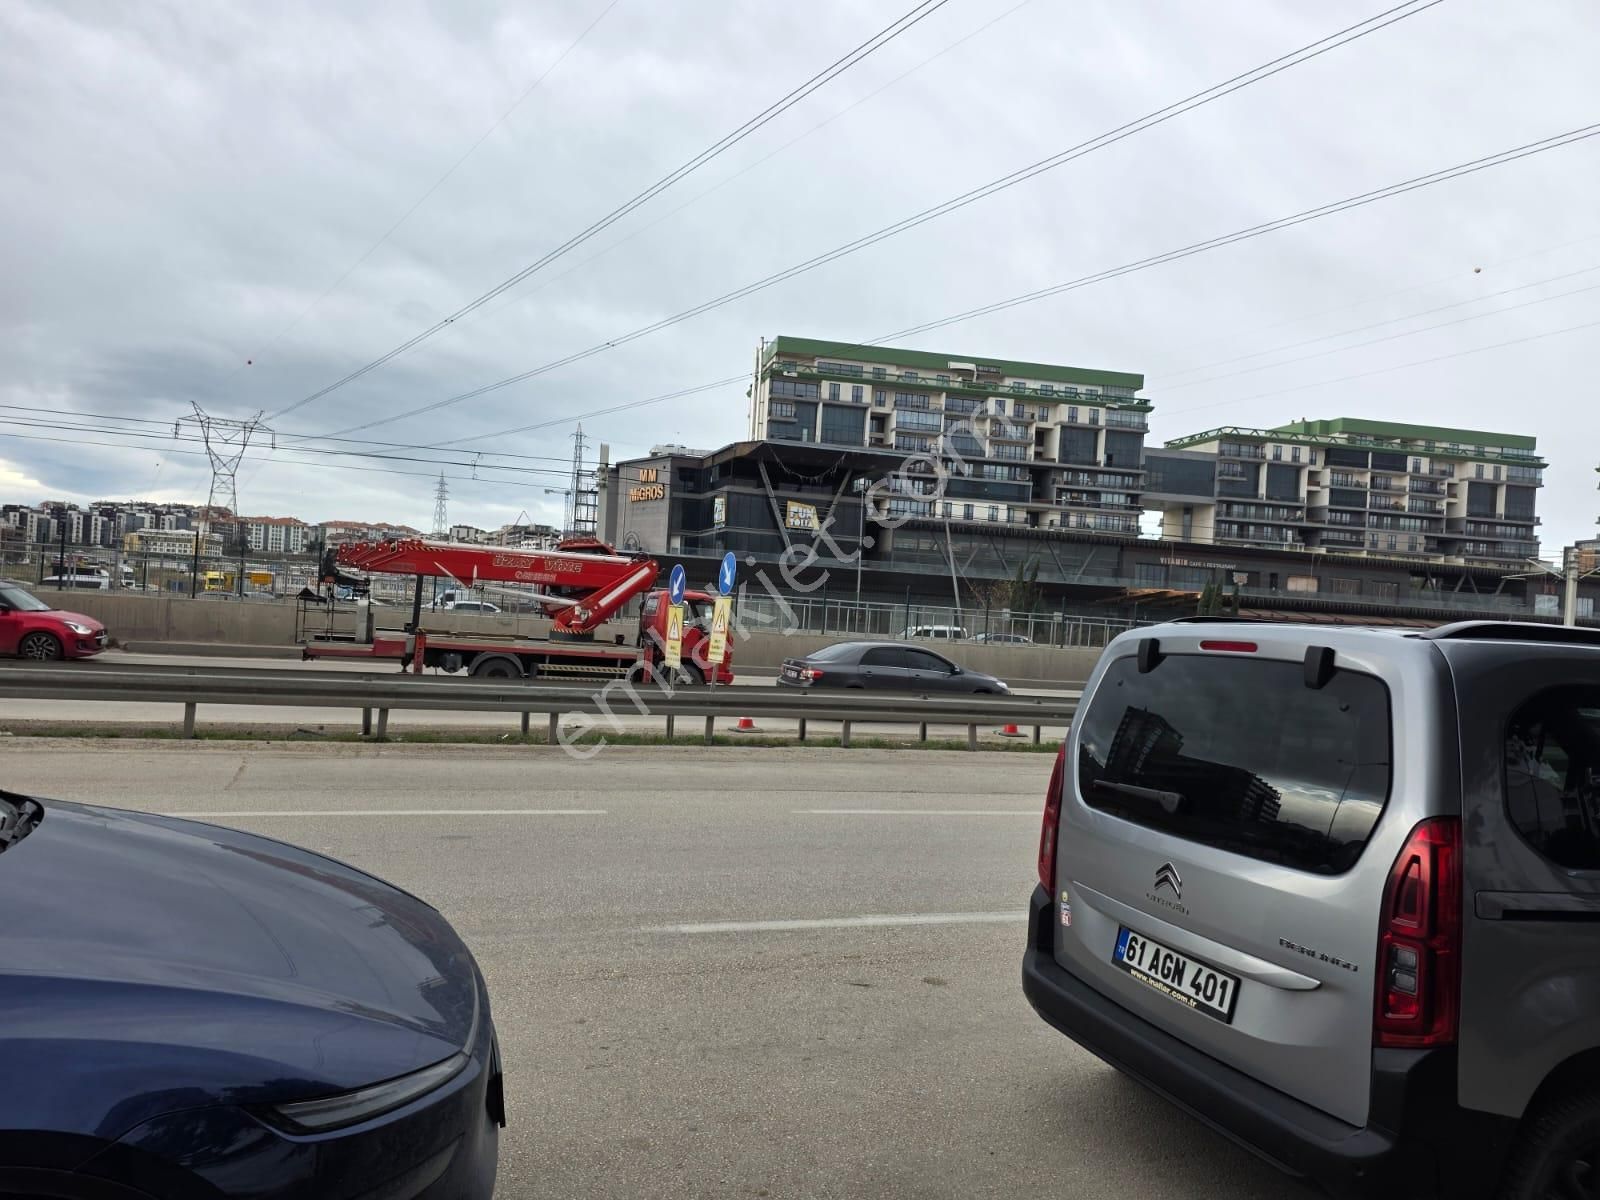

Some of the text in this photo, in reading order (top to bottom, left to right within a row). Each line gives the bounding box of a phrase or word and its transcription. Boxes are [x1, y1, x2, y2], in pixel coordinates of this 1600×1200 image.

[640, 468, 658, 482] MM
[1125, 935, 1229, 1008] 61 AGN 401
[1279, 937, 1358, 972] BERLINGO
